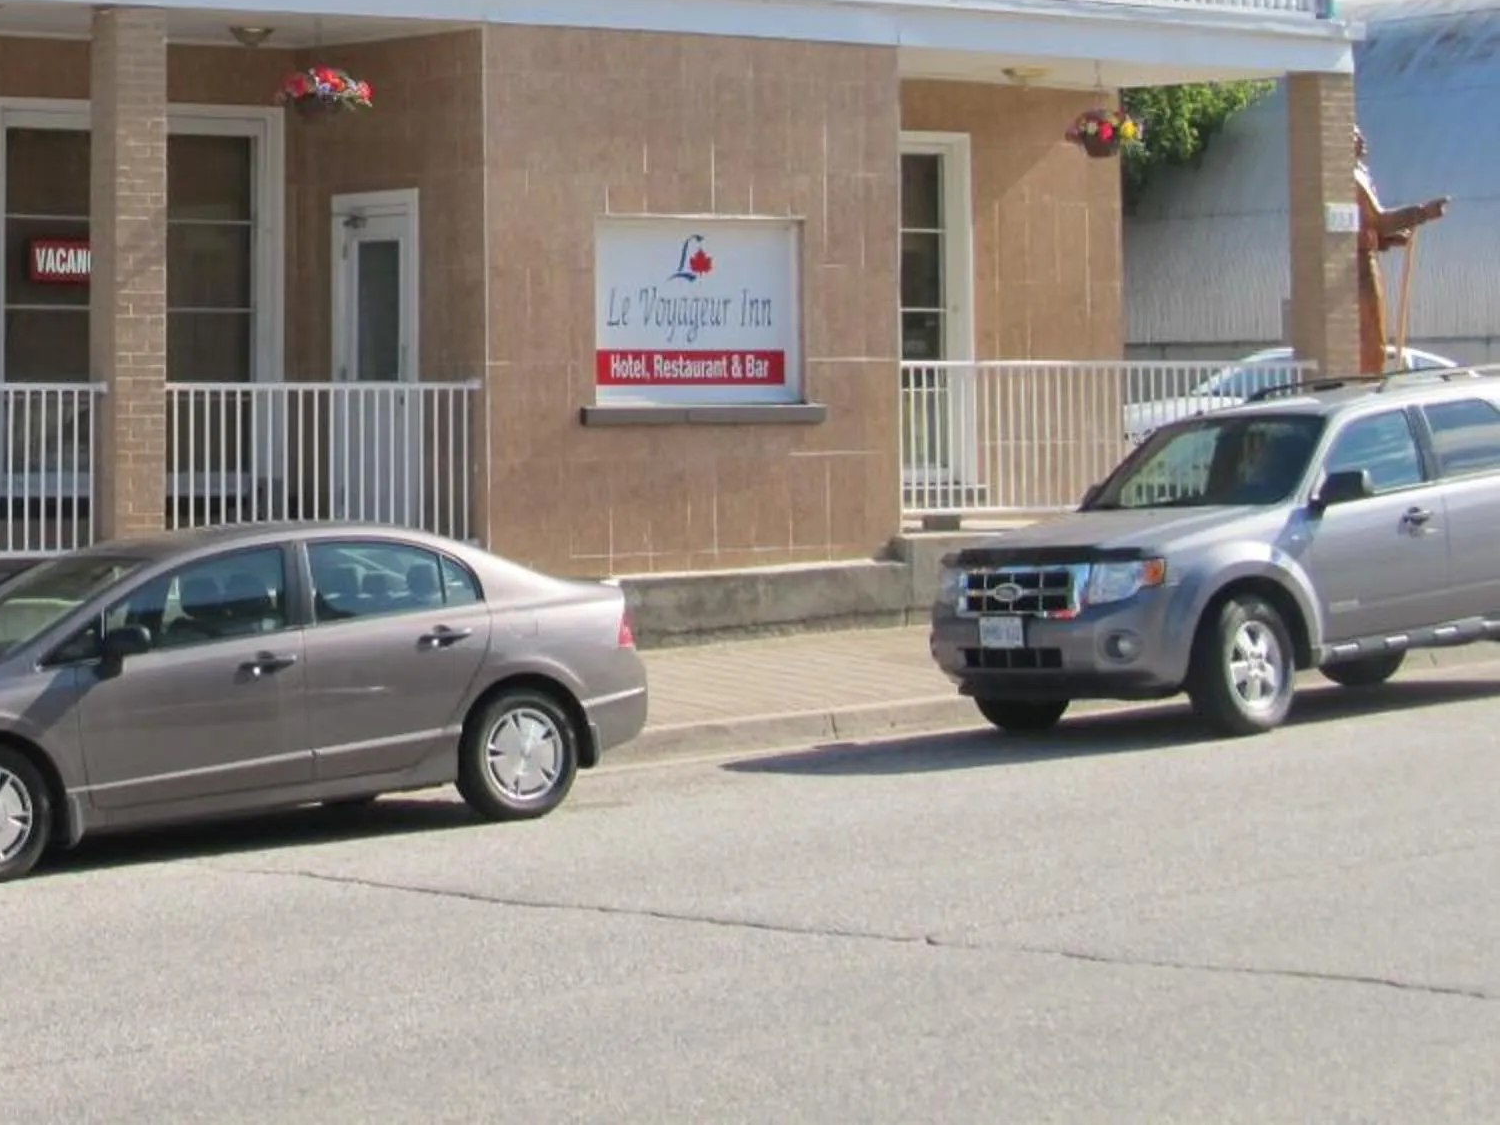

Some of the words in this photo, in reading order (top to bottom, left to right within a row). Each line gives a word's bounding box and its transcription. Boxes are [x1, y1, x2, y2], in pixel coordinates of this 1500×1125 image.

[36, 248, 91, 274] VACAN
[606, 287, 631, 327] Le
[639, 286, 732, 343] Voyageur
[741, 288, 772, 327] Inn
[653, 354, 728, 378] Restaurant
[731, 354, 742, 378] &
[745, 354, 769, 379] Bar
